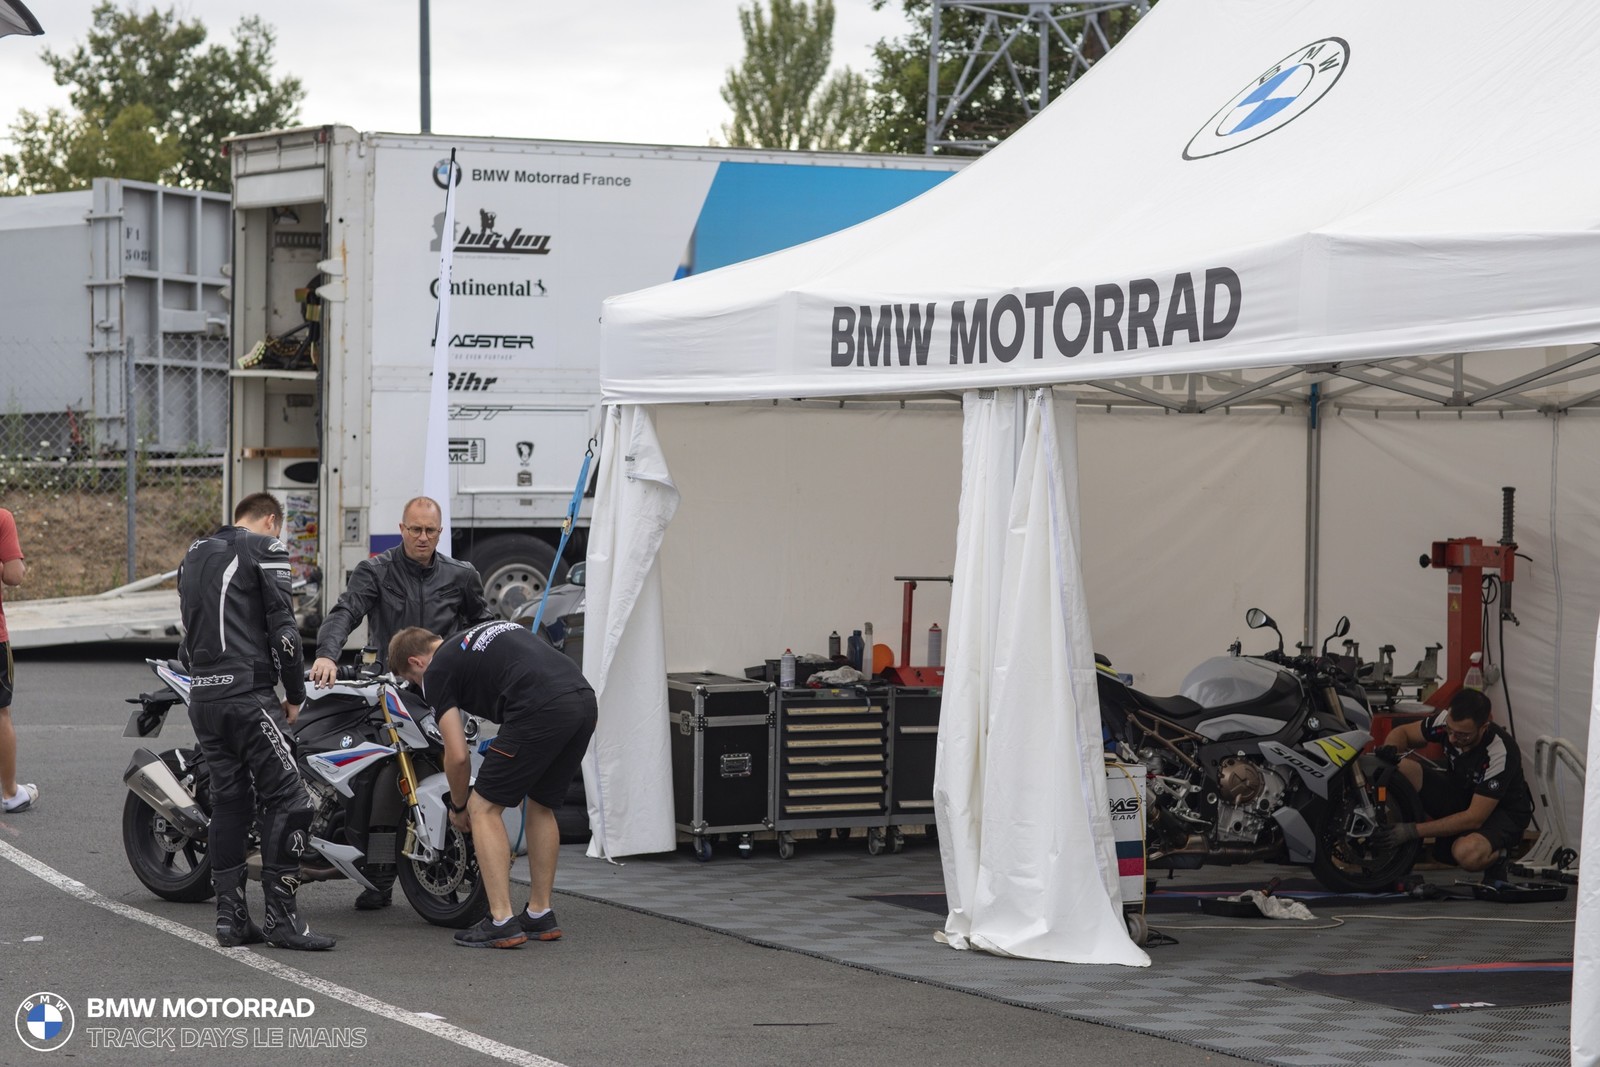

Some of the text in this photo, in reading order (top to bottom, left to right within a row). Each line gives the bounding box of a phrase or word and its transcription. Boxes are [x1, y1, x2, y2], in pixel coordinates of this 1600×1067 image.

[1258, 43, 1341, 86] BMW
[472, 168, 632, 187] BMW Motorrad France
[430, 278, 531, 299] Cntinental
[830, 266, 1242, 367] BMW MOTORRAD
[431, 334, 534, 349] AGSTER
[1269, 746, 1325, 779] S1000
